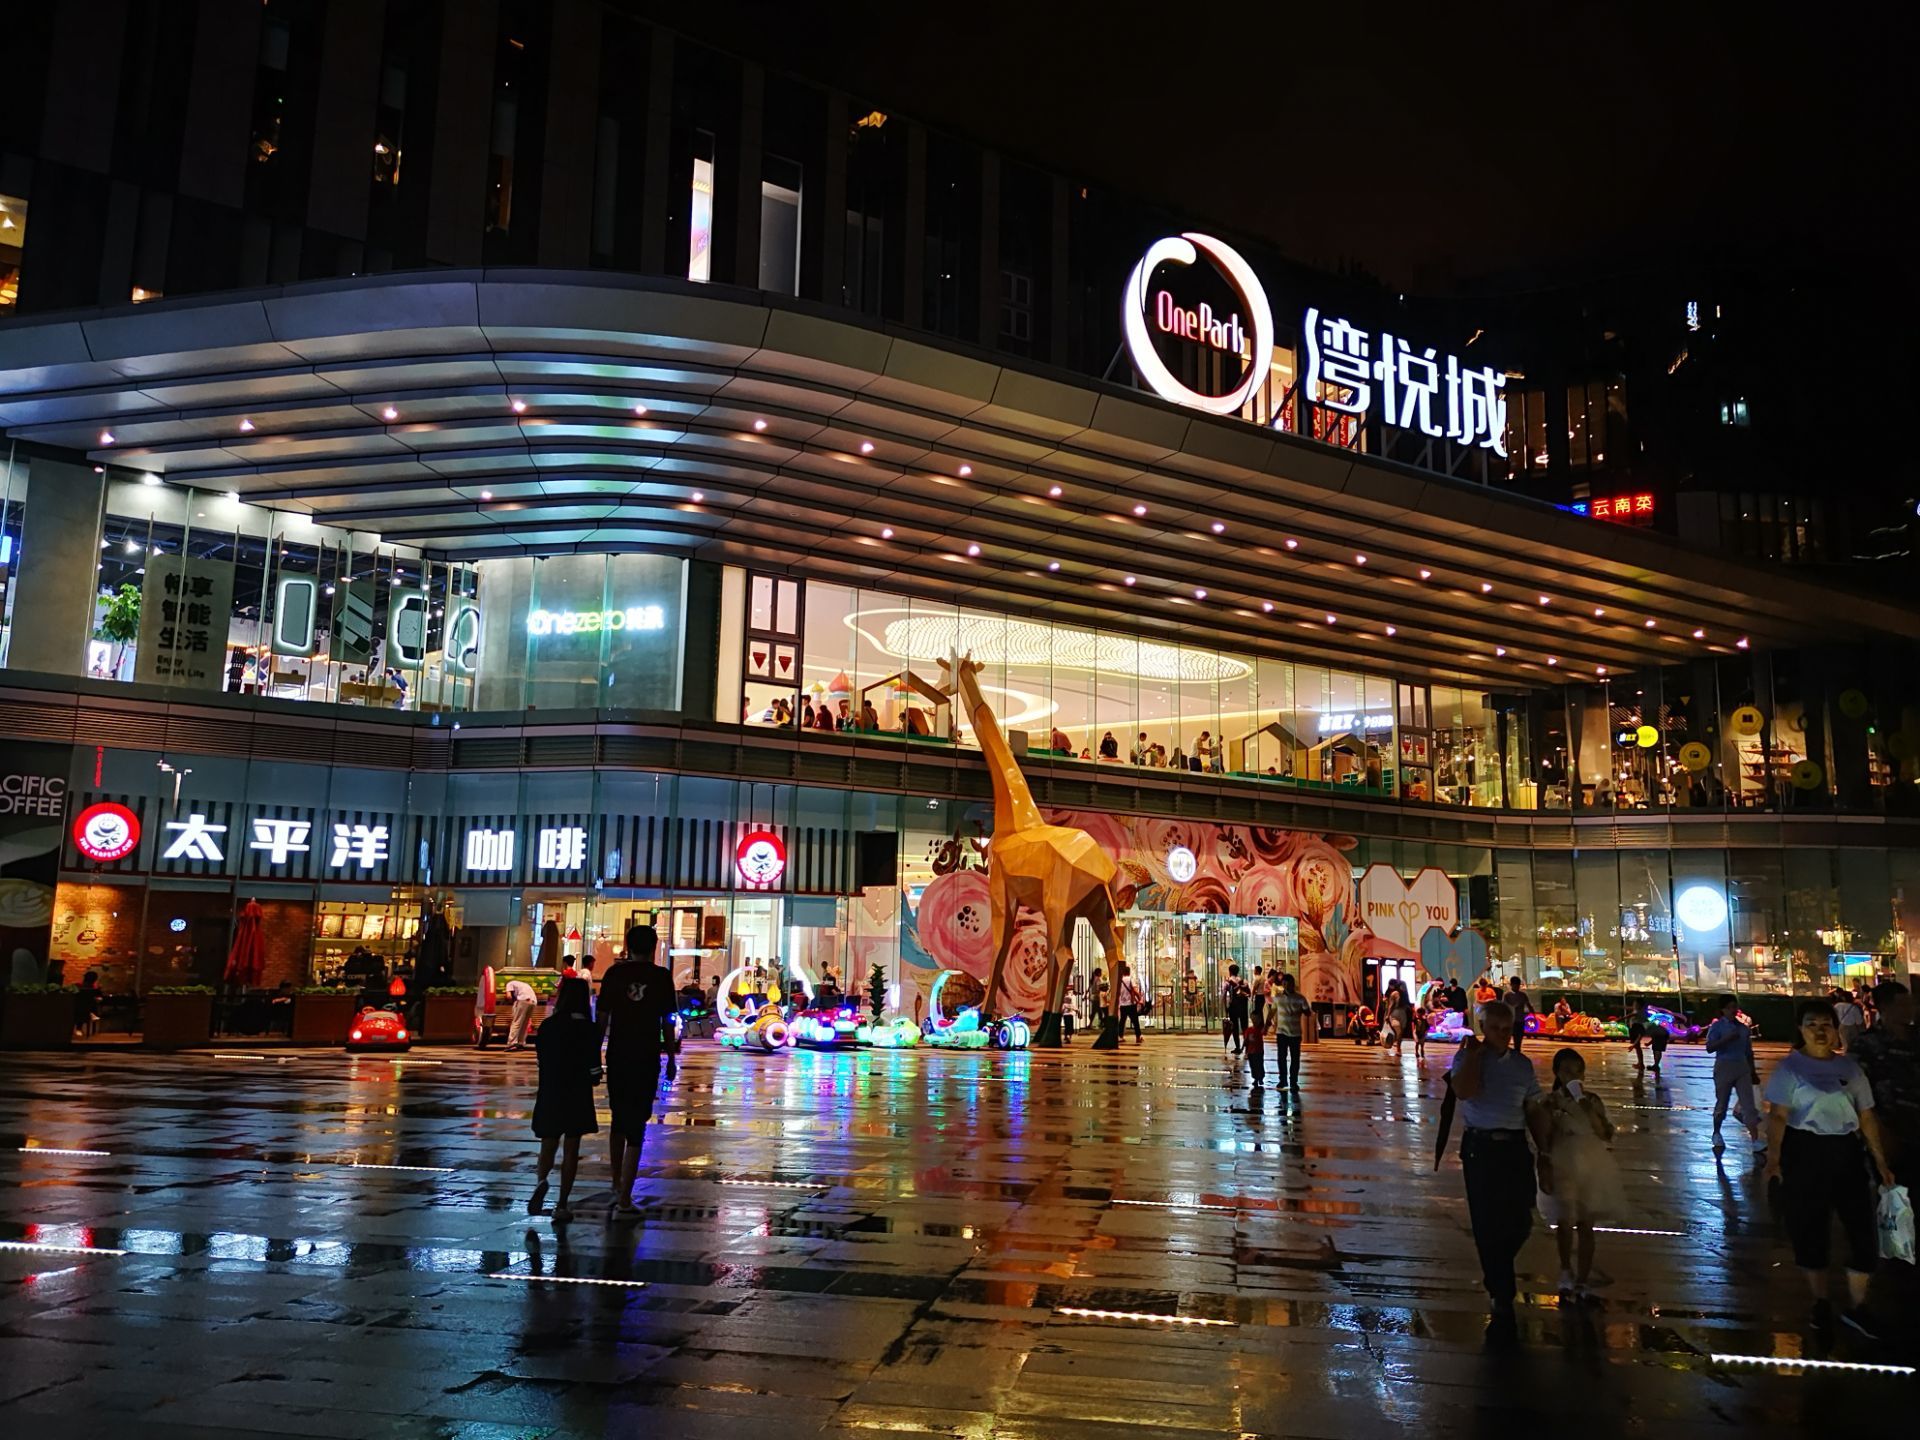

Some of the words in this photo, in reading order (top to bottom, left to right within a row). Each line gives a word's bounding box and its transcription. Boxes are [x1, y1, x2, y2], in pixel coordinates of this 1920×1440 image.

[1305, 307, 1508, 457] 湾悦城
[162, 599, 211, 625] 智能
[158, 626, 208, 652] 生活
[0, 775, 65, 796] CIFIC
[1368, 902, 1395, 917] PINK
[1426, 906, 1449, 921] YOU
